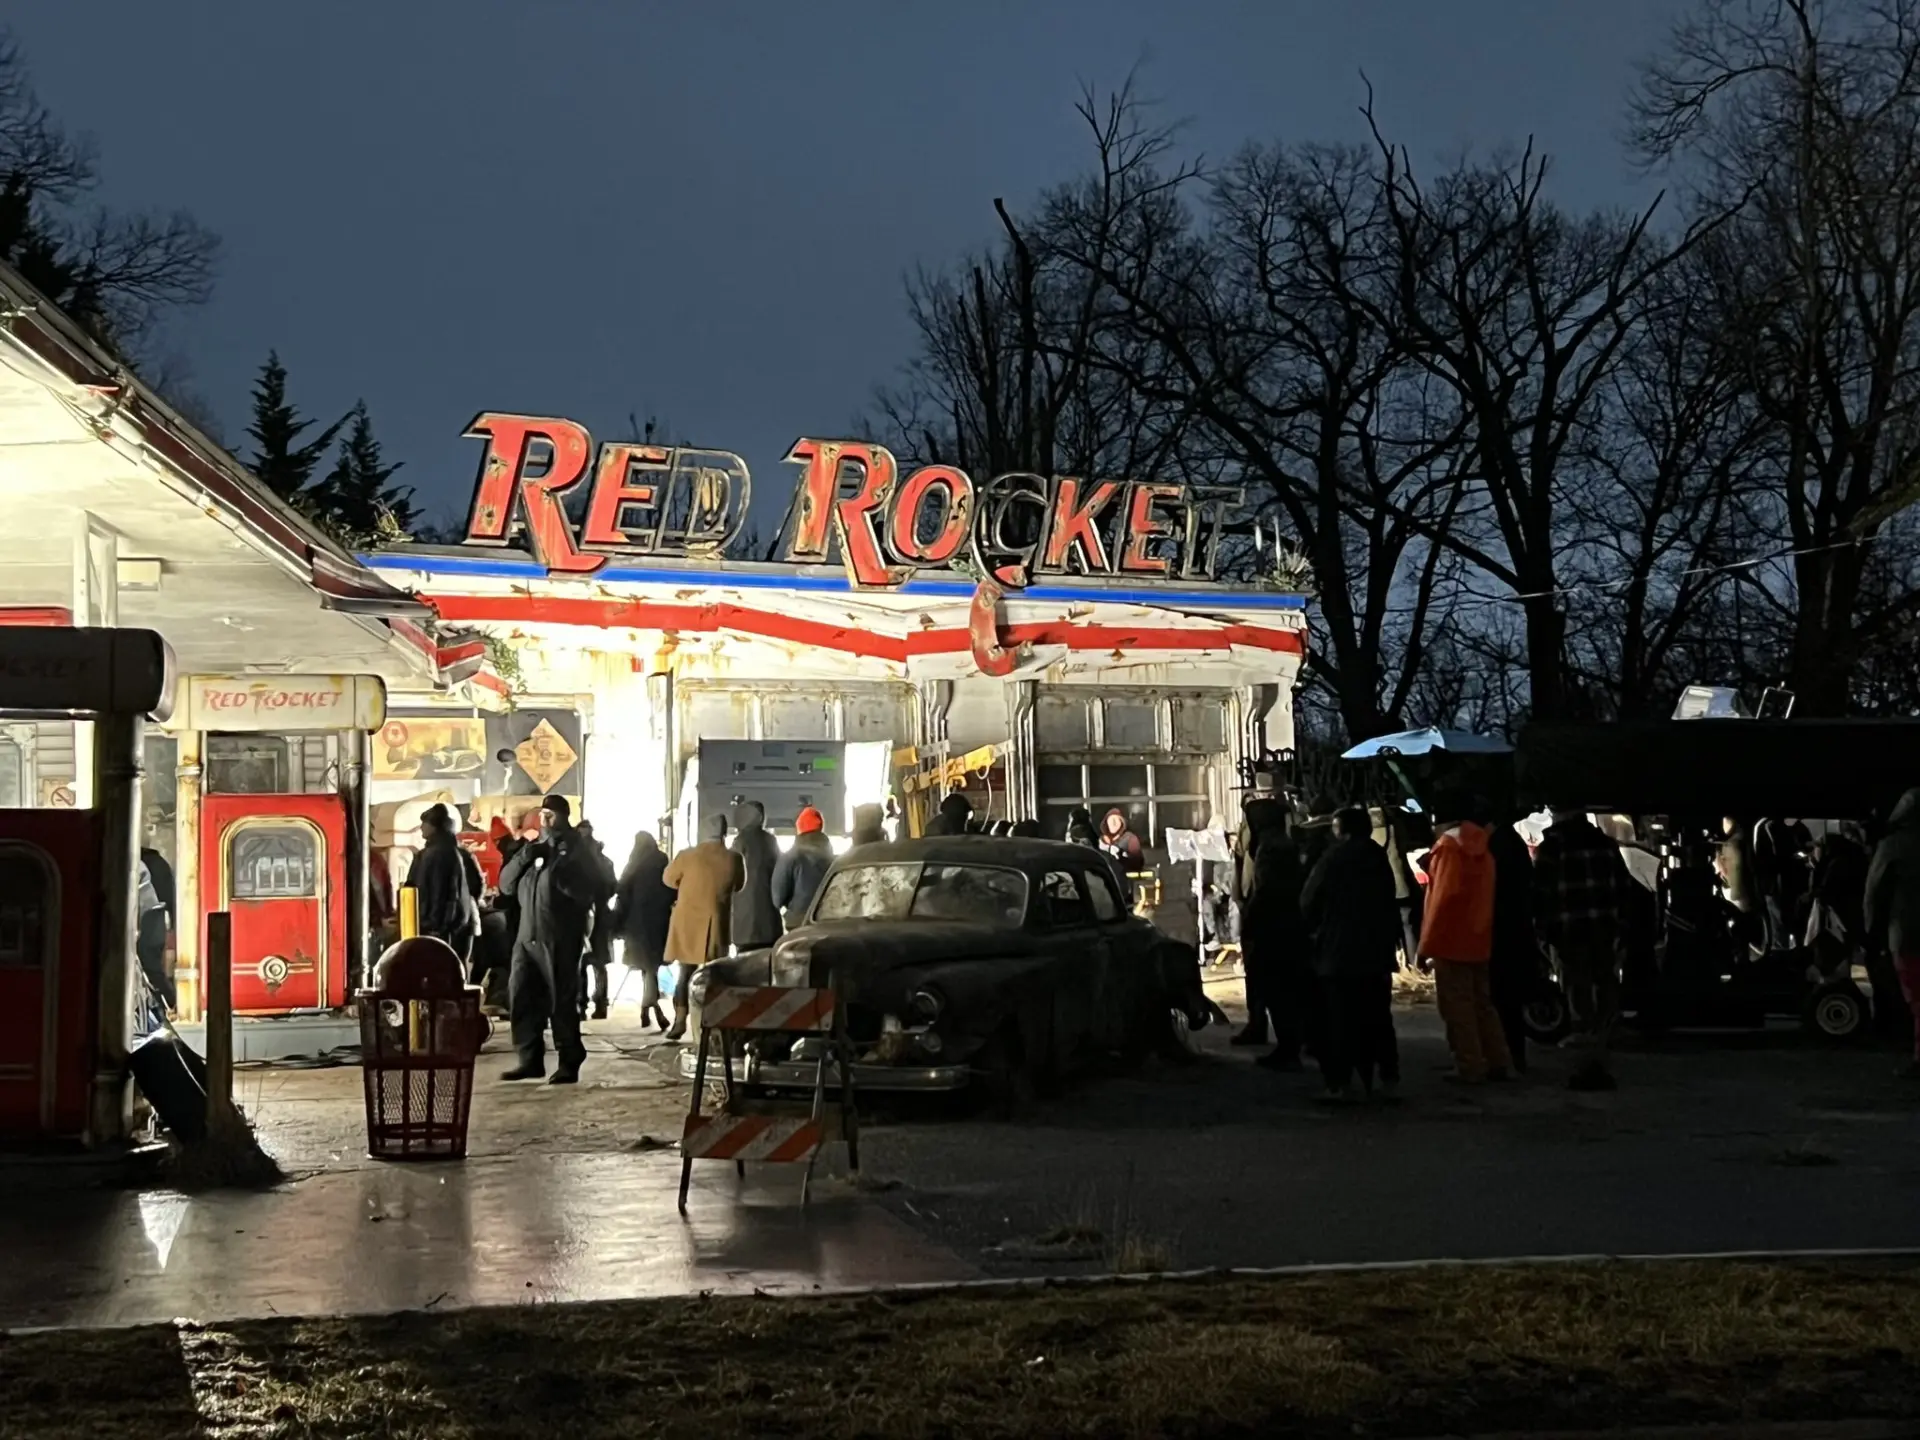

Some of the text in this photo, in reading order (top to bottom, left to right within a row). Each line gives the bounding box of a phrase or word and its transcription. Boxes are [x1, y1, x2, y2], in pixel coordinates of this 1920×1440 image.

[461, 411, 1246, 589] RED ROCKET
[203, 688, 343, 713] RED ROCKET
